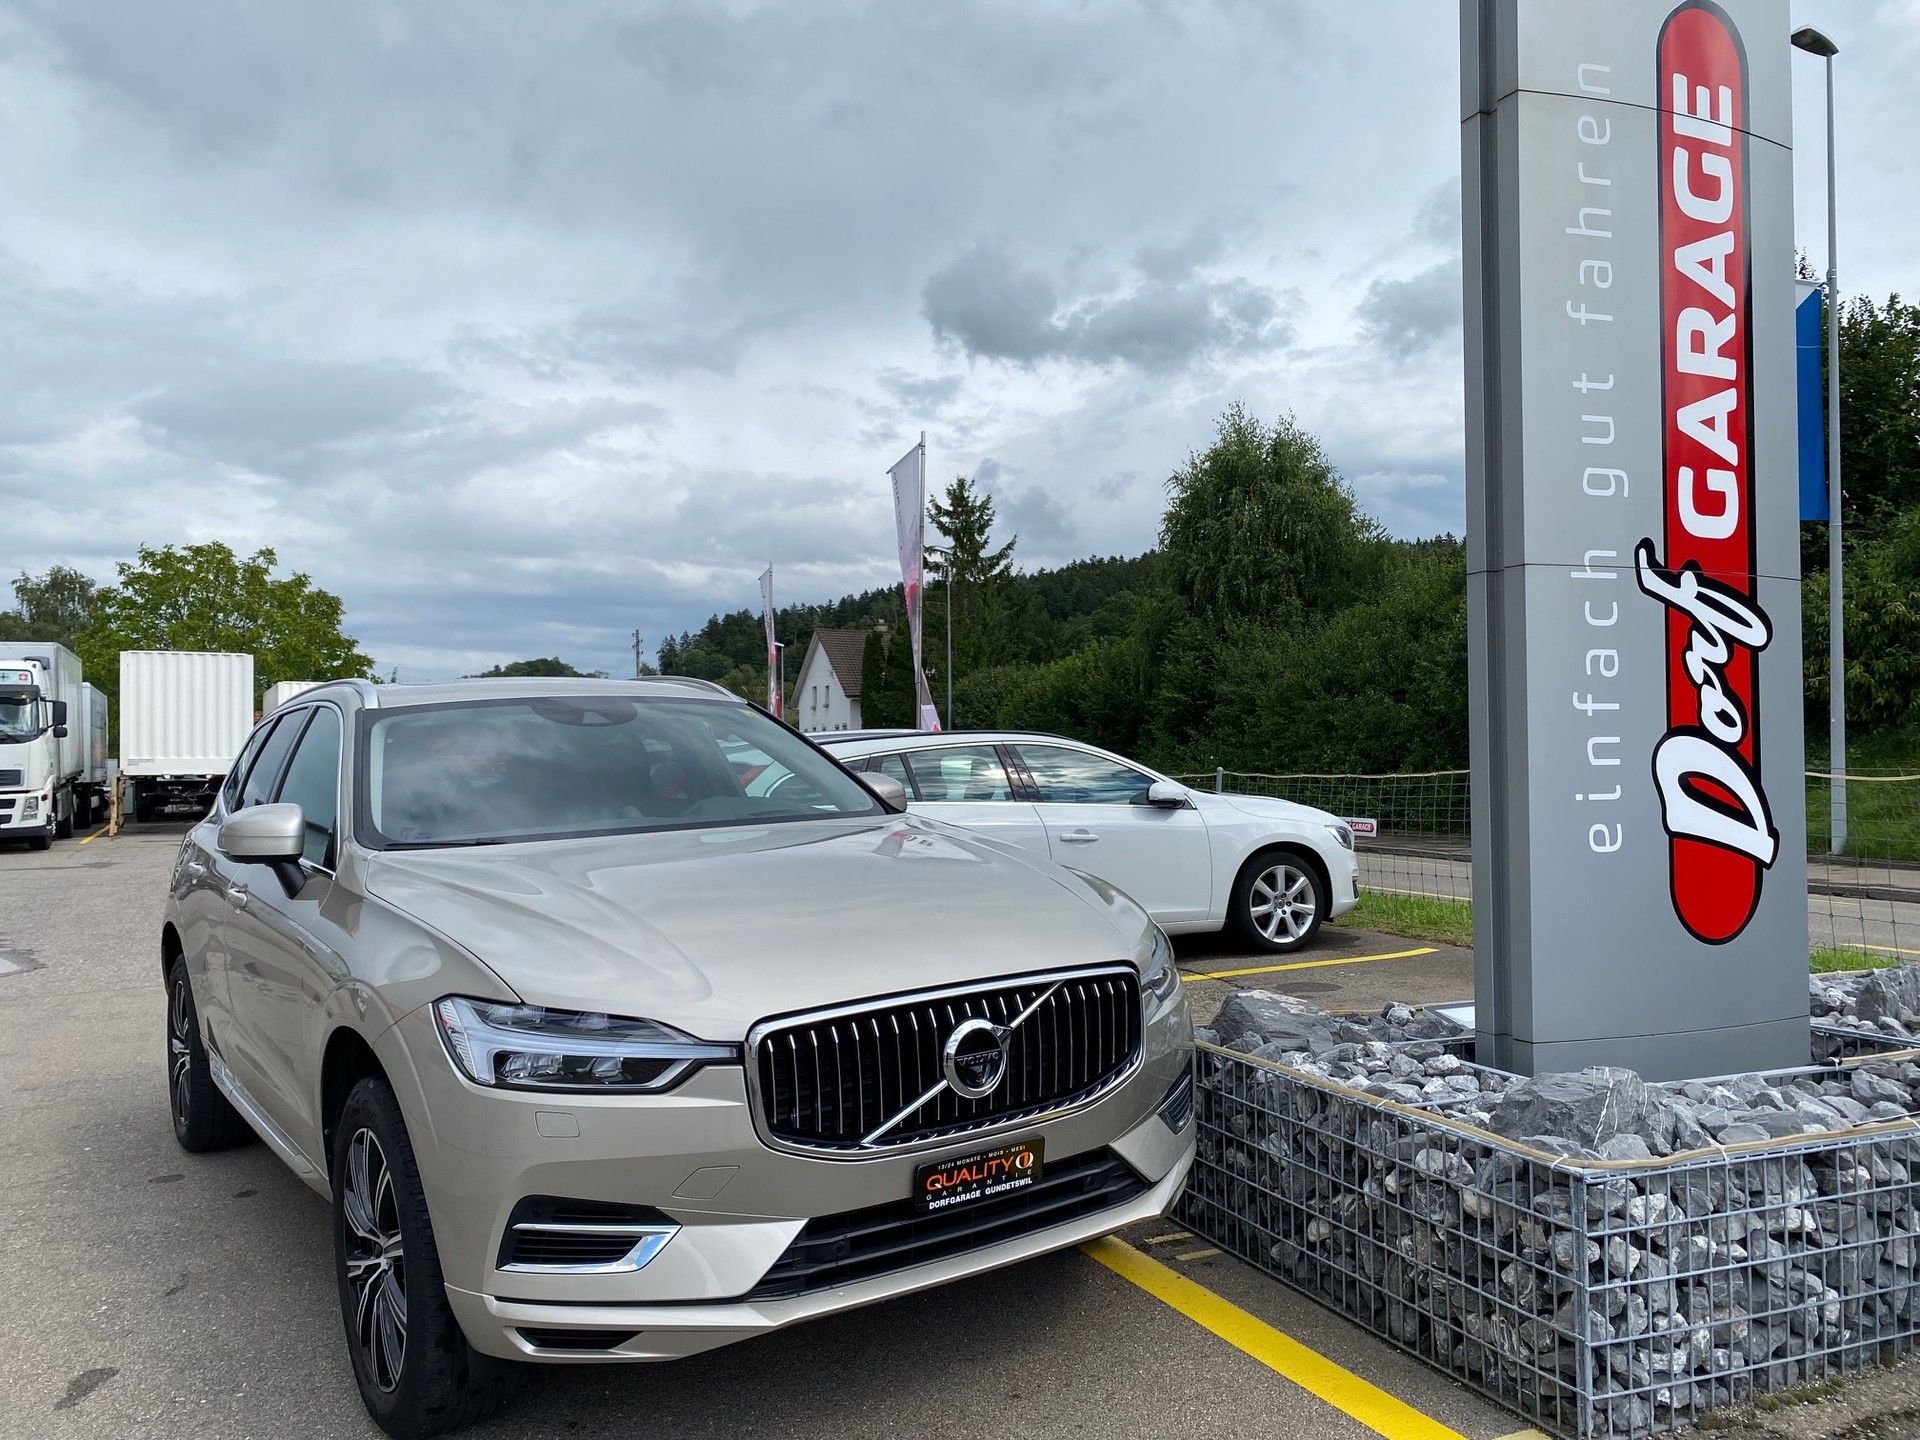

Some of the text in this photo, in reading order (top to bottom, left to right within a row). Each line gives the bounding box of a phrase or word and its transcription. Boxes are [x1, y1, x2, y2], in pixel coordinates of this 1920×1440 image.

[1566, 62, 1629, 854] einfach gut fahren
[1637, 73, 1777, 867] Dorf GARAGE
[1351, 822, 1374, 831] GARAGE
[957, 1051, 1000, 1066] VOLVO
[926, 1156, 1014, 1191] QUALITY
[956, 1155, 980, 1166] MONATE
[988, 1150, 1003, 1158] MOIS
[926, 1169, 1032, 1200] GARANTIE
[929, 1177, 1033, 1210] DORFGARAGE GUNDETSWIL
